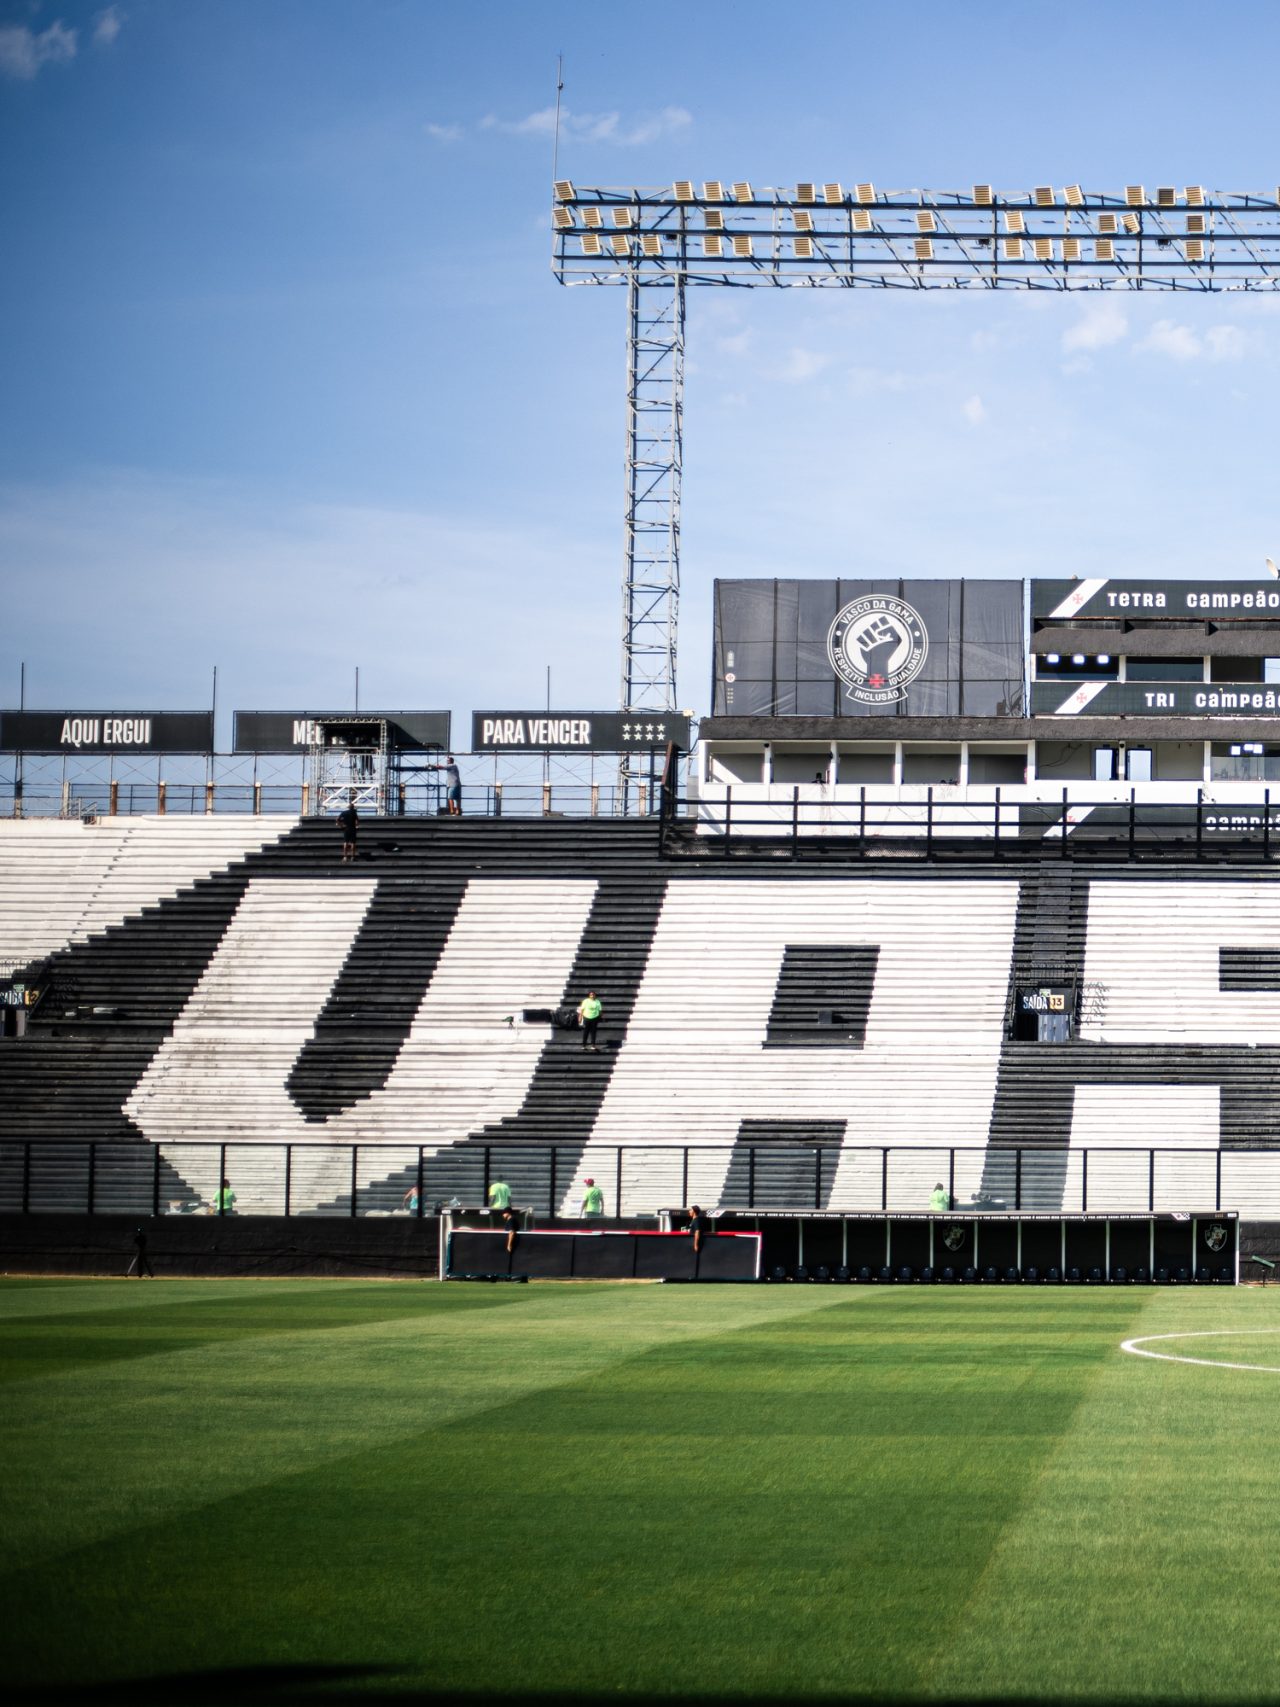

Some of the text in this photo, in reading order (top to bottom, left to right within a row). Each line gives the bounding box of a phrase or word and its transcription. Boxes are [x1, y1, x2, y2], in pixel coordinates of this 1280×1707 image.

[840, 600, 915, 625] VASCO DA GAMA
[833, 647, 865, 685] RESPEITO
[888, 647, 922, 686] IGUALDADE
[854, 689, 900, 701] INCLUSÃO
[1144, 692, 1175, 708] TRI
[60, 719, 150, 747] AQUI ERGUI
[483, 719, 591, 745] PARA VENCER
[1023, 994, 1062, 1010] SAÍDA 13
